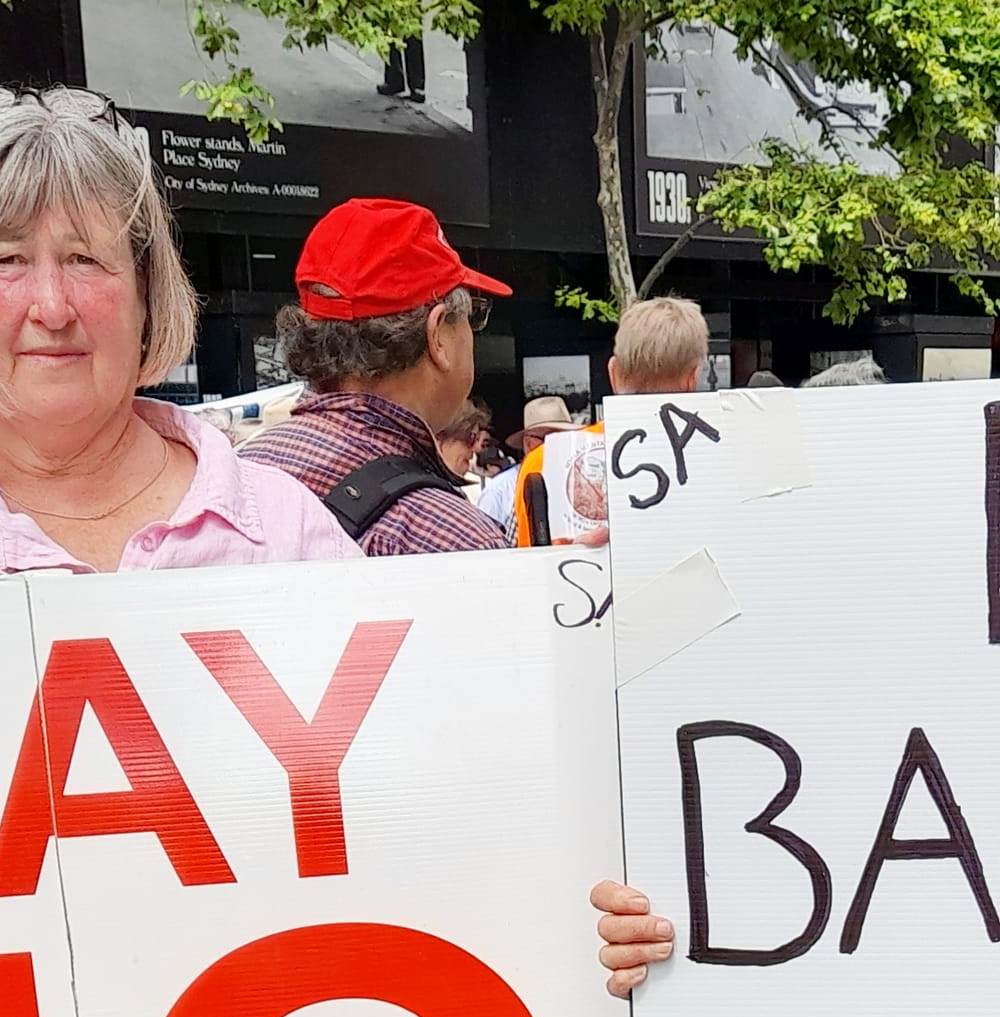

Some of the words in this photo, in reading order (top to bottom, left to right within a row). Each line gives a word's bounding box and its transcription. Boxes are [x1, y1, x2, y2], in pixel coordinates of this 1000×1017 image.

[161, 129, 202, 148] Flower
[248, 140, 287, 156] Martin
[163, 149, 195, 167] Place
[198, 151, 241, 173] Sydney
[164, 175, 184, 189] City
[185, 177, 194, 189] of
[197, 178, 229, 193] Sydney
[612, 402, 720, 510] SA
